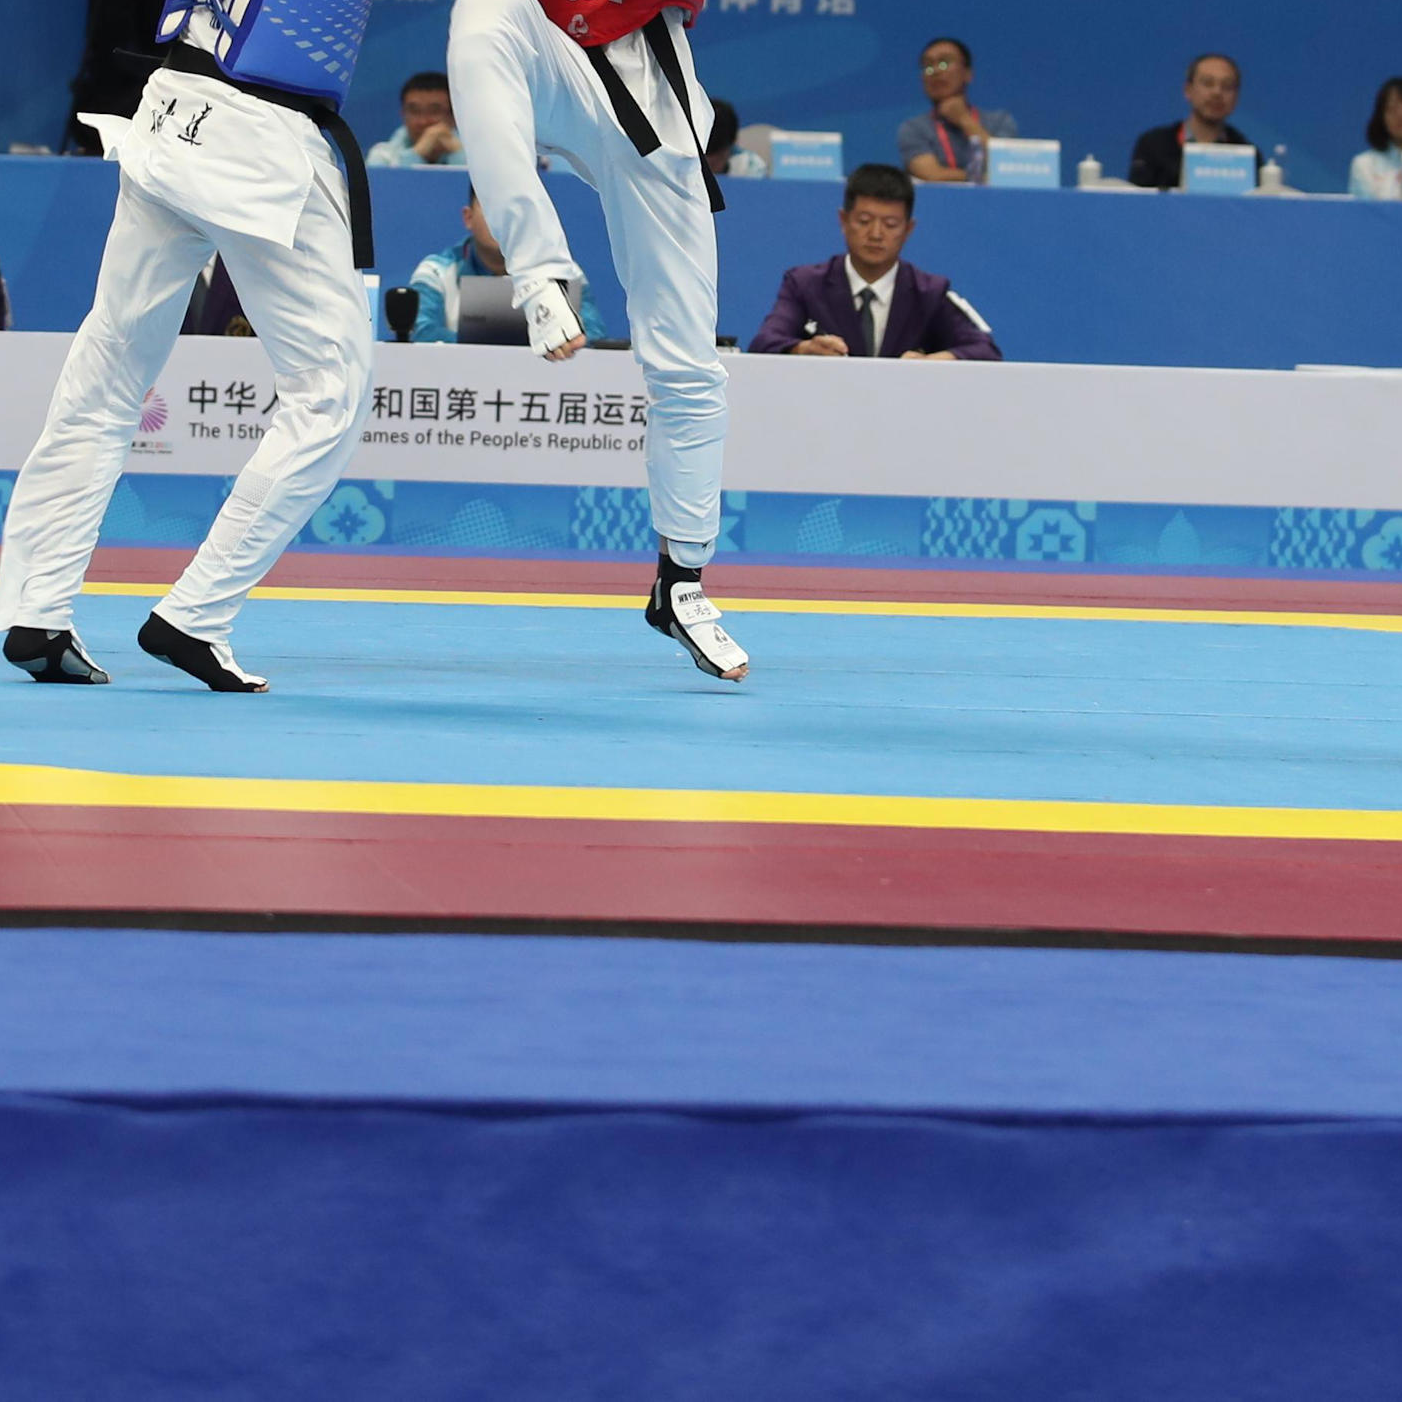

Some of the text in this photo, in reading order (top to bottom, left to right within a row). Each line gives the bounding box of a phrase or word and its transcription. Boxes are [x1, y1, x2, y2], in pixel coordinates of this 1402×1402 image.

[189, 422, 221, 438] The
[227, 423, 265, 439] 15th
[360, 430, 409, 444] ames
[415, 429, 433, 445] of
[438, 429, 465, 445] the
[548, 433, 622, 452] Republic
[627, 435, 645, 451] of
